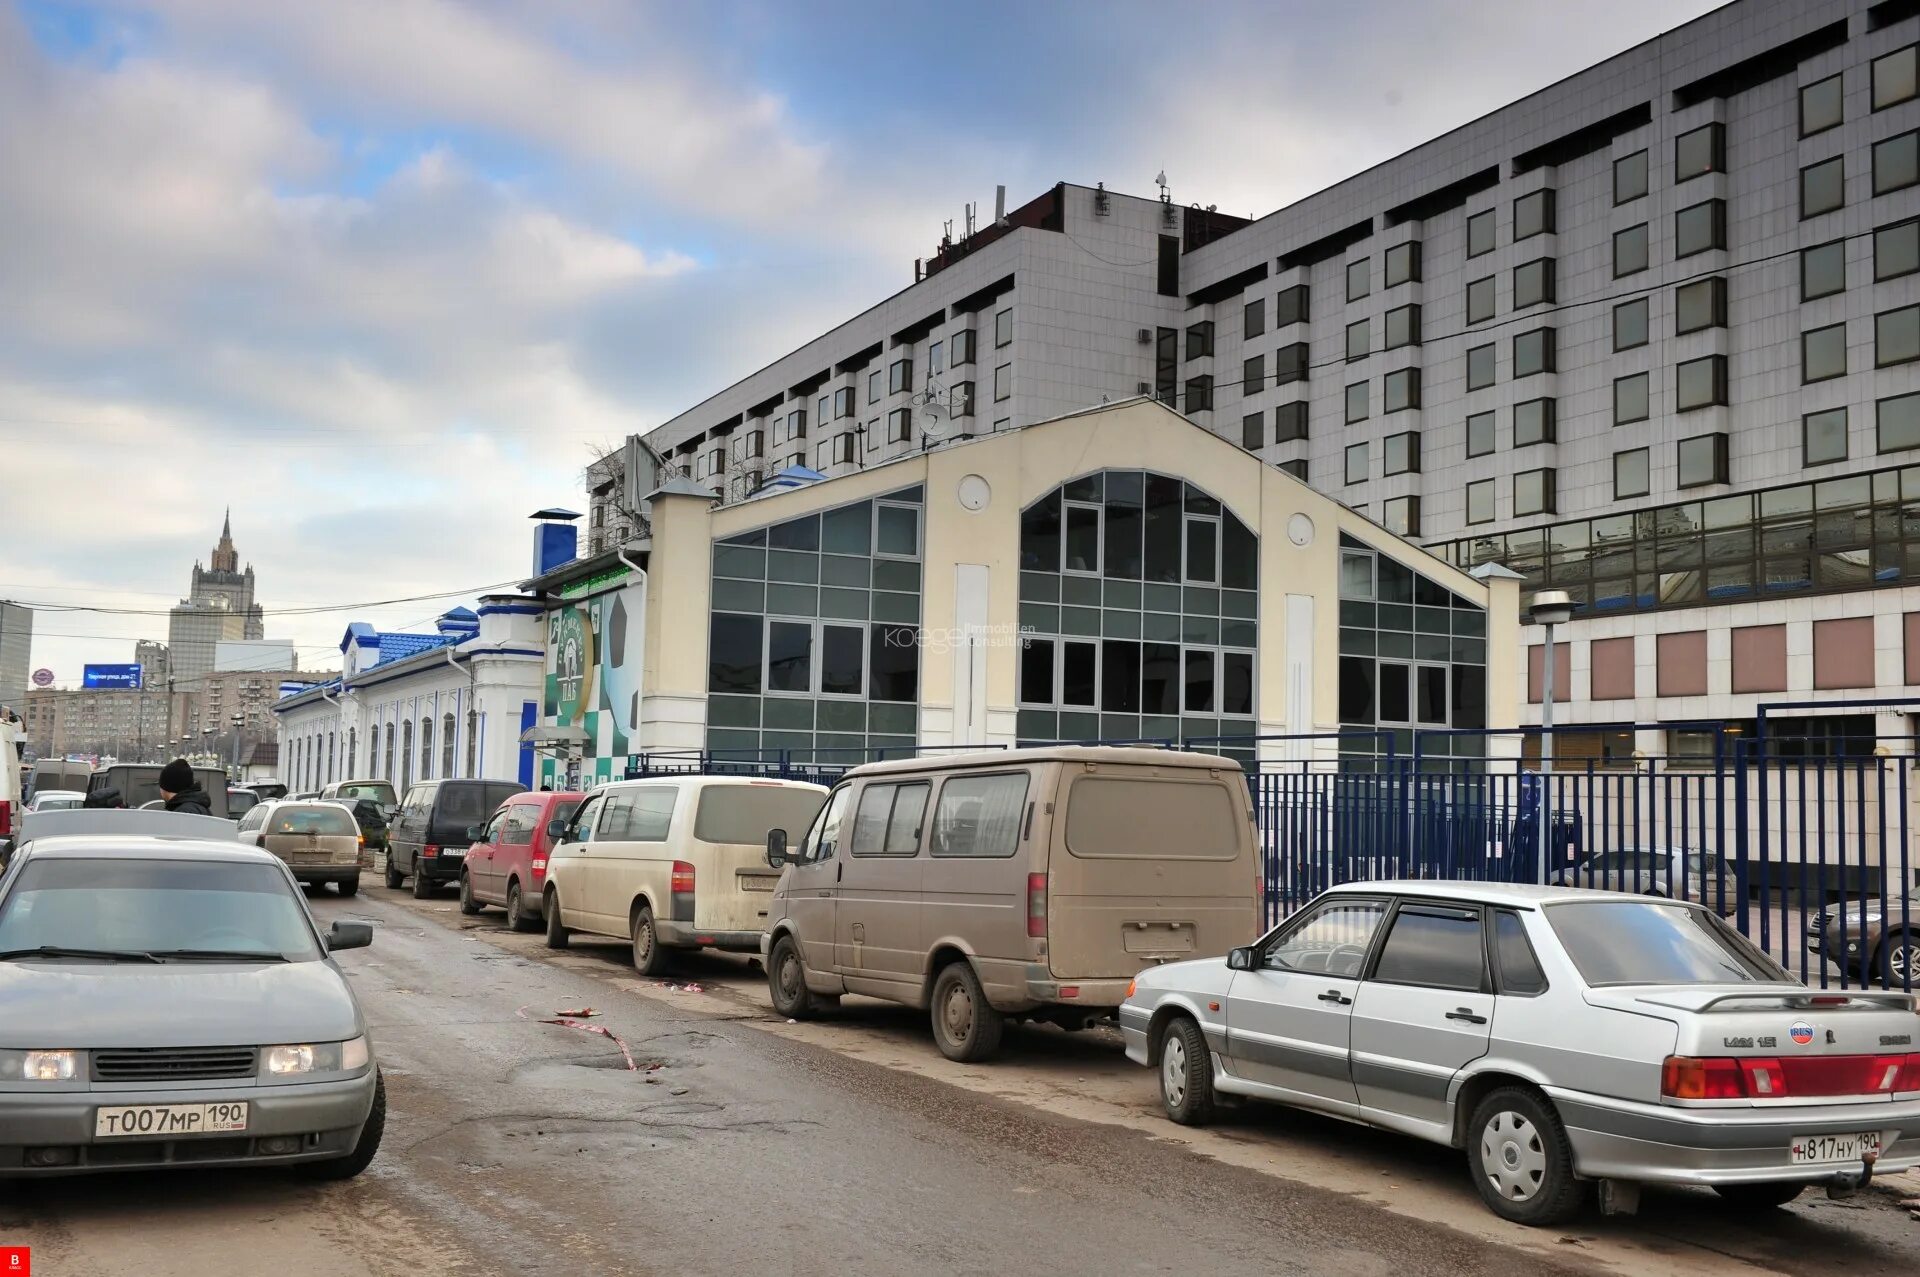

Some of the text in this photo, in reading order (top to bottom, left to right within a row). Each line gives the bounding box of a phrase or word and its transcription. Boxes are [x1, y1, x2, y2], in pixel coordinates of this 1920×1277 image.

[562, 682, 576, 702] ПАБ
[106, 1104, 241, 1132] Т007МР 190
[1797, 1134, 1876, 1160] Н817НУ 190
